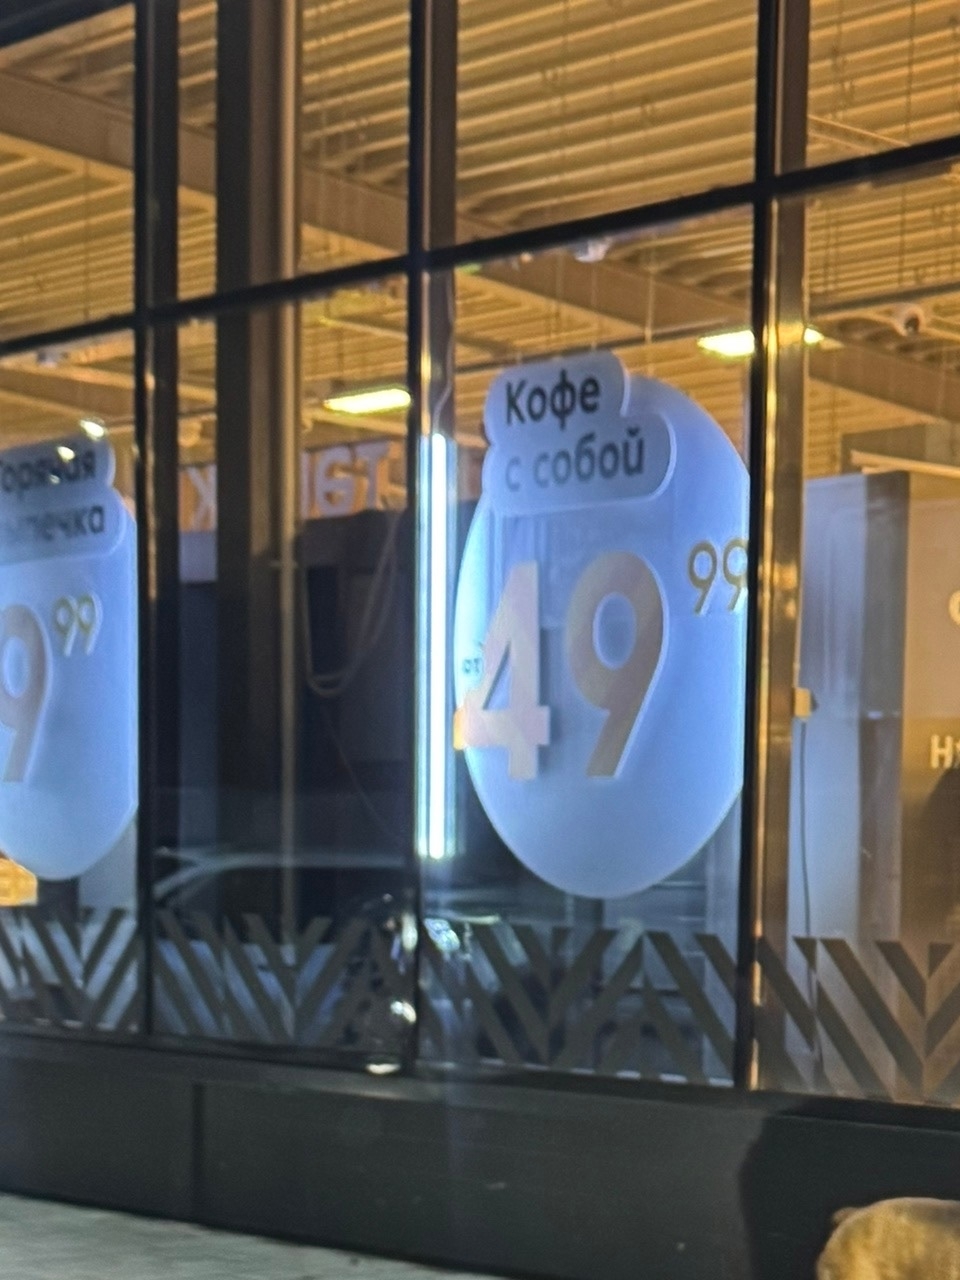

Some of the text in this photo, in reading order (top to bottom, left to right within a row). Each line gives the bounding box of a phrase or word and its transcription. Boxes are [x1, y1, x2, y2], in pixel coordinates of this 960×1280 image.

[505, 369, 600, 431] Кофе
[505, 428, 646, 491] с собой
[688, 538, 748, 616] 99
[54, 594, 100, 657] 99
[453, 550, 667, 780] 49
